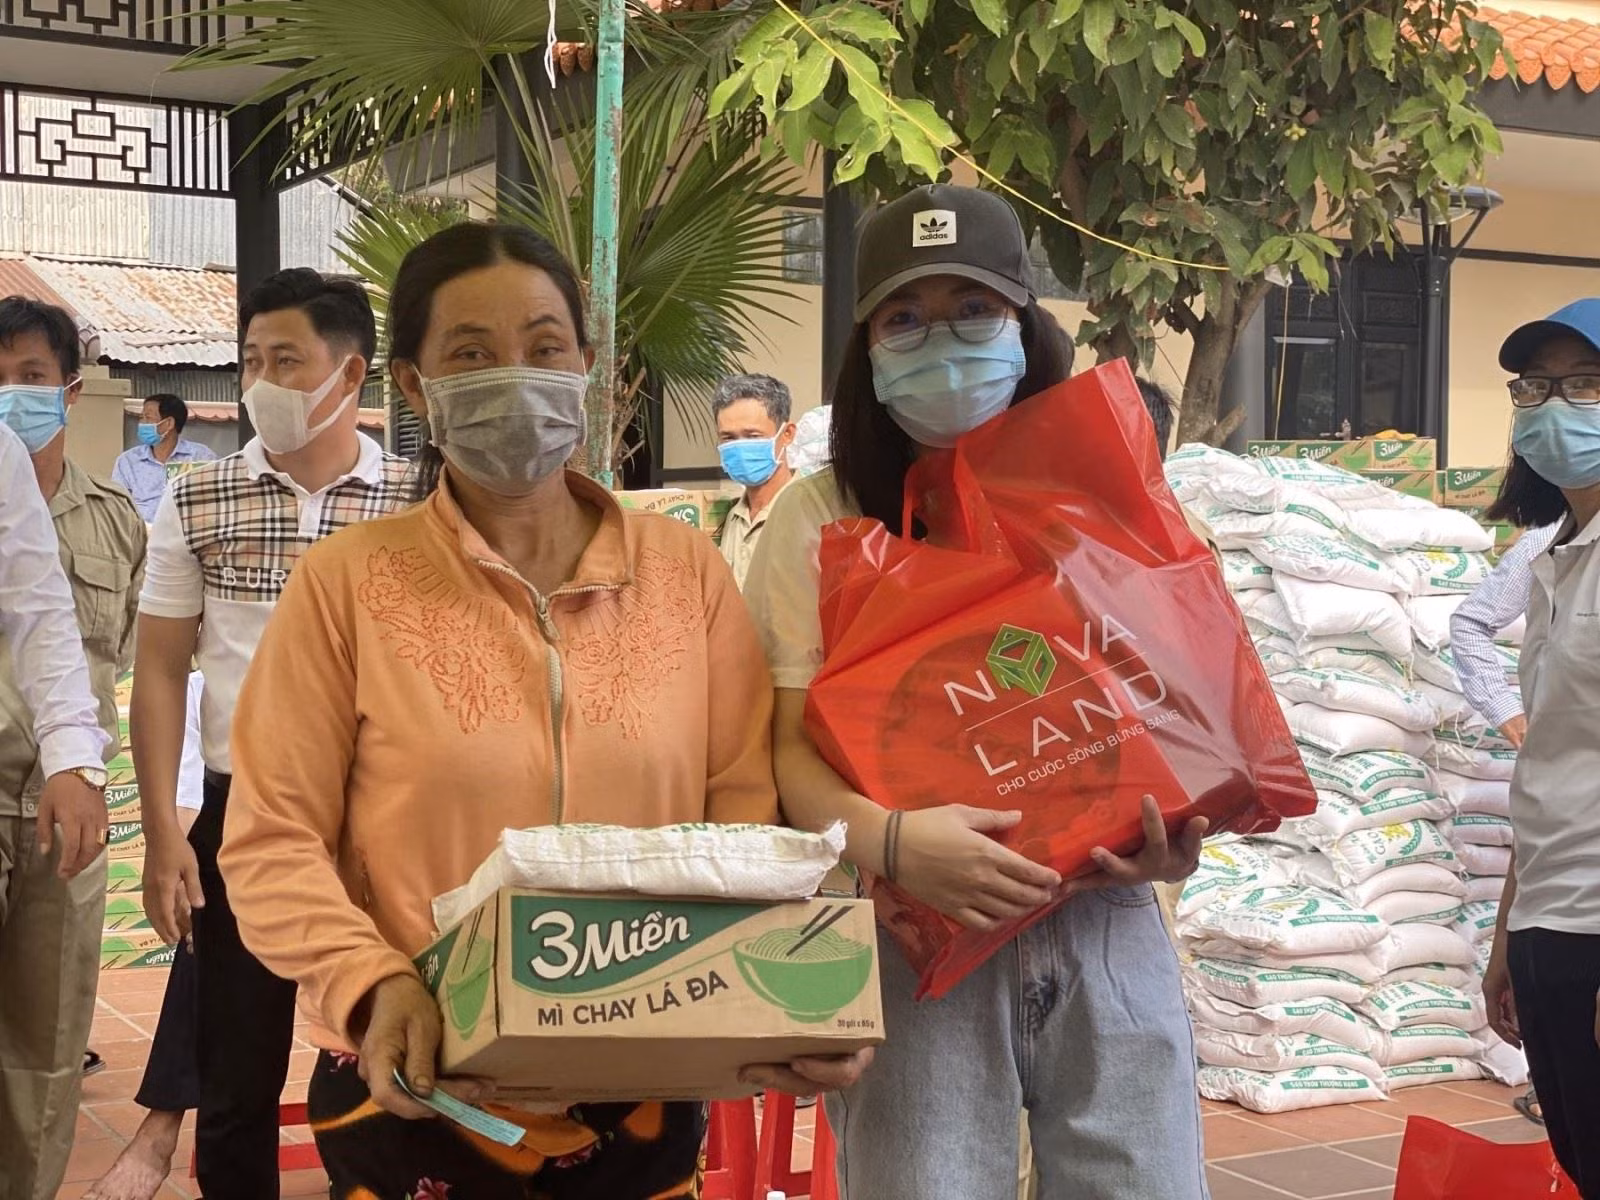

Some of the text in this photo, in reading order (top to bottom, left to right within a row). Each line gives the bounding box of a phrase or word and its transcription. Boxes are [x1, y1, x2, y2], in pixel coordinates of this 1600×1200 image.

[974, 670, 1167, 776] LAND
[996, 776, 1026, 796] CHO
[1028, 759, 1066, 781] CUỘC
[574, 910, 690, 977] Miền
[538, 970, 729, 1026] MÌ CHAY LÁ ĐA
